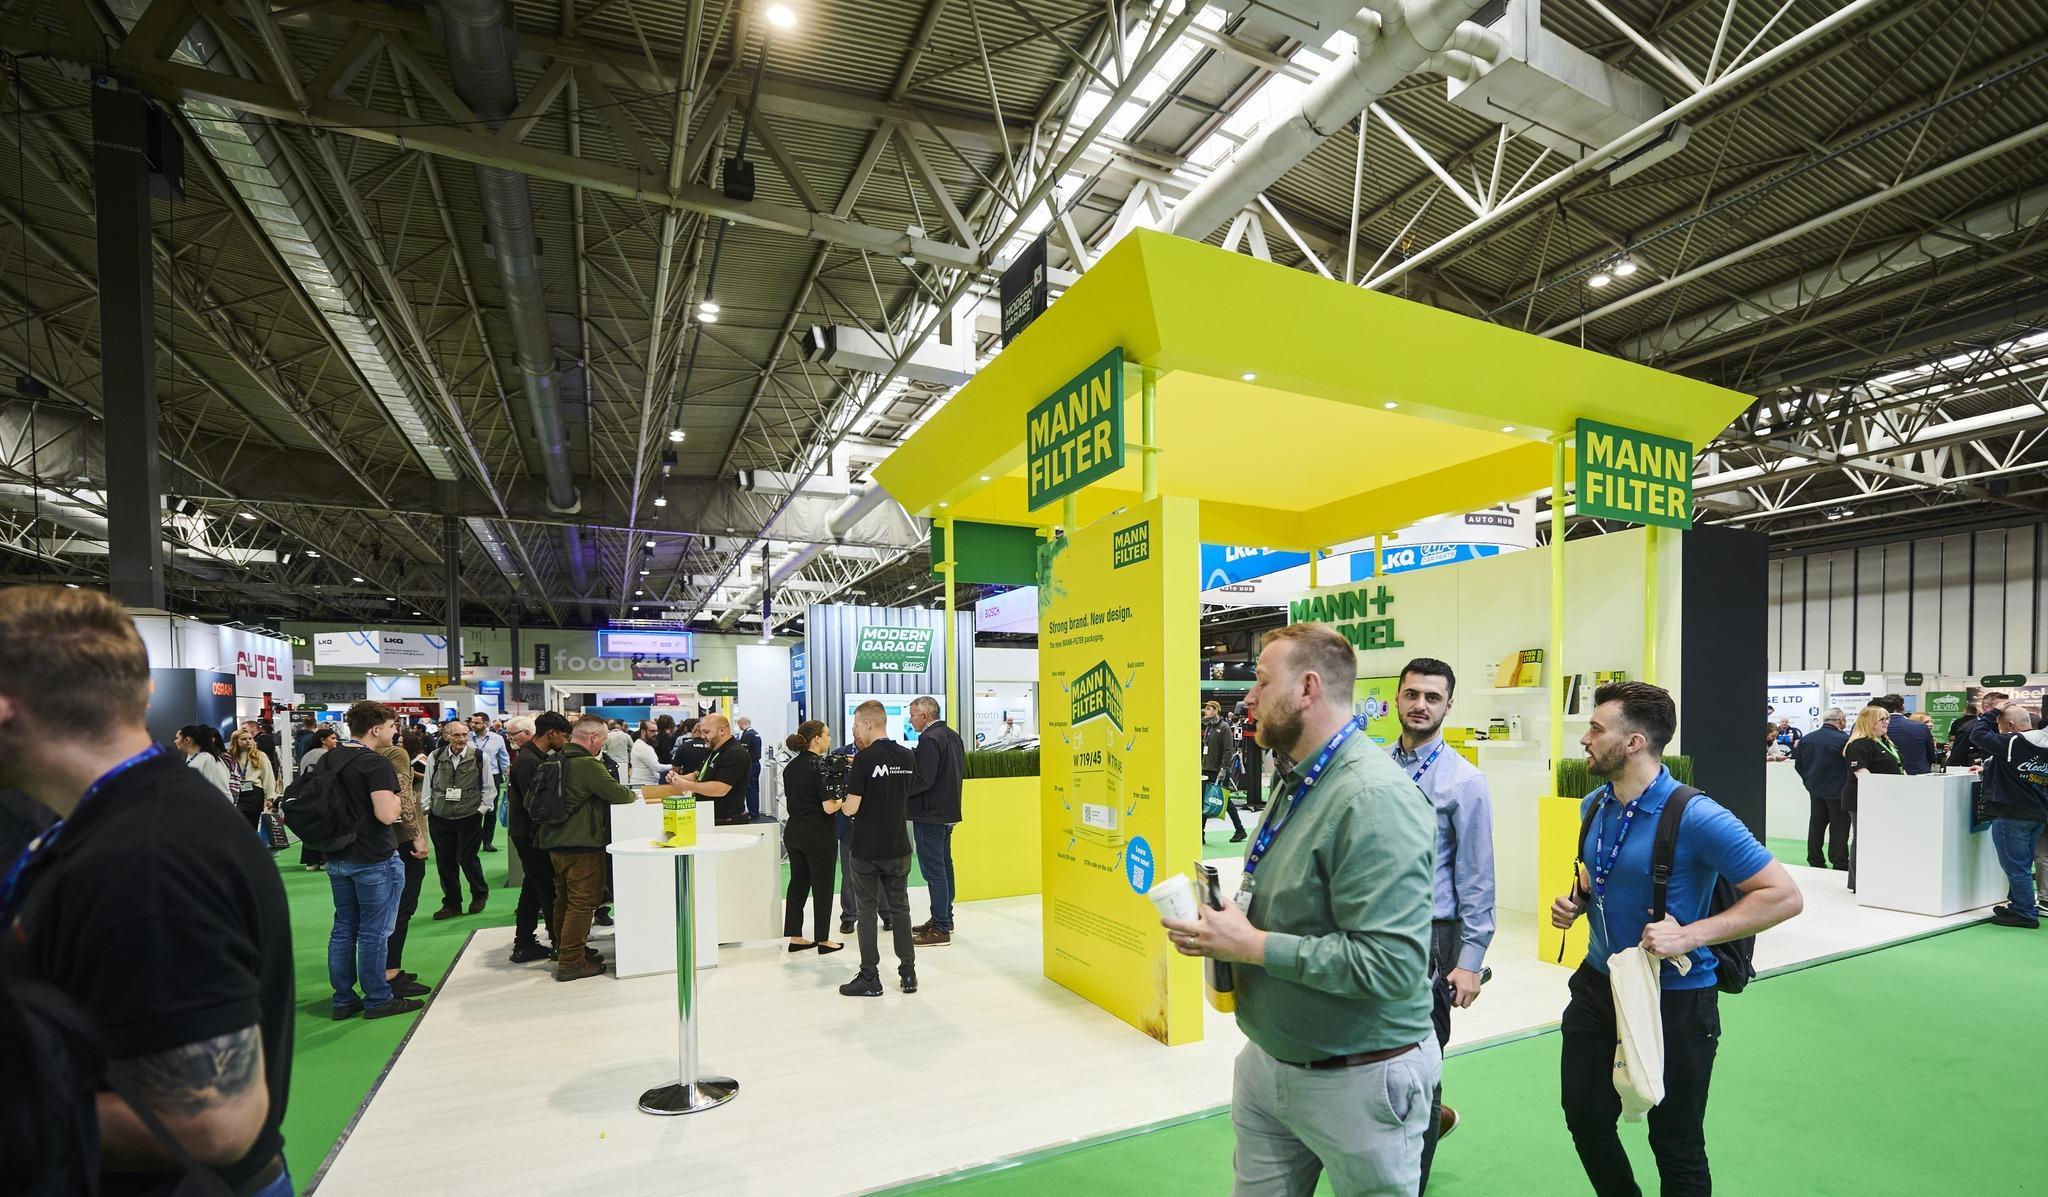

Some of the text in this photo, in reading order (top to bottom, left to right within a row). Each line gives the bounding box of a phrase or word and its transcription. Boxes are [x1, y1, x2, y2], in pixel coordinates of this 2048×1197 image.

[1005, 285, 1033, 319] MODERN
[1005, 299, 1032, 331] GARAGE
[1031, 367, 1111, 456] MANN
[1031, 419, 1112, 497] FILTER
[1586, 431, 1686, 482] MANN
[1586, 471, 1686, 519] FILTER
[1468, 515, 1513, 526] AUTO HUB
[1115, 525, 1148, 549] MANN
[1115, 542, 1148, 565] FILTER
[985, 606, 1000, 618] BOSCH
[1049, 606, 1133, 634] Strong brand. New design.
[861, 640, 927, 652] GARAGE
[863, 628, 931, 641] MODERN
[1336, 618, 1405, 650] MEL
[237, 651, 282, 681] AUTEL
[872, 662, 899, 670] LKQ
[212, 682, 233, 696] OSRAM
[1072, 668, 1103, 702] MANN
[1072, 689, 1104, 720] FILTER
[1933, 703, 1959, 711] HEVRA
[1073, 750, 1102, 767] W 719/45
